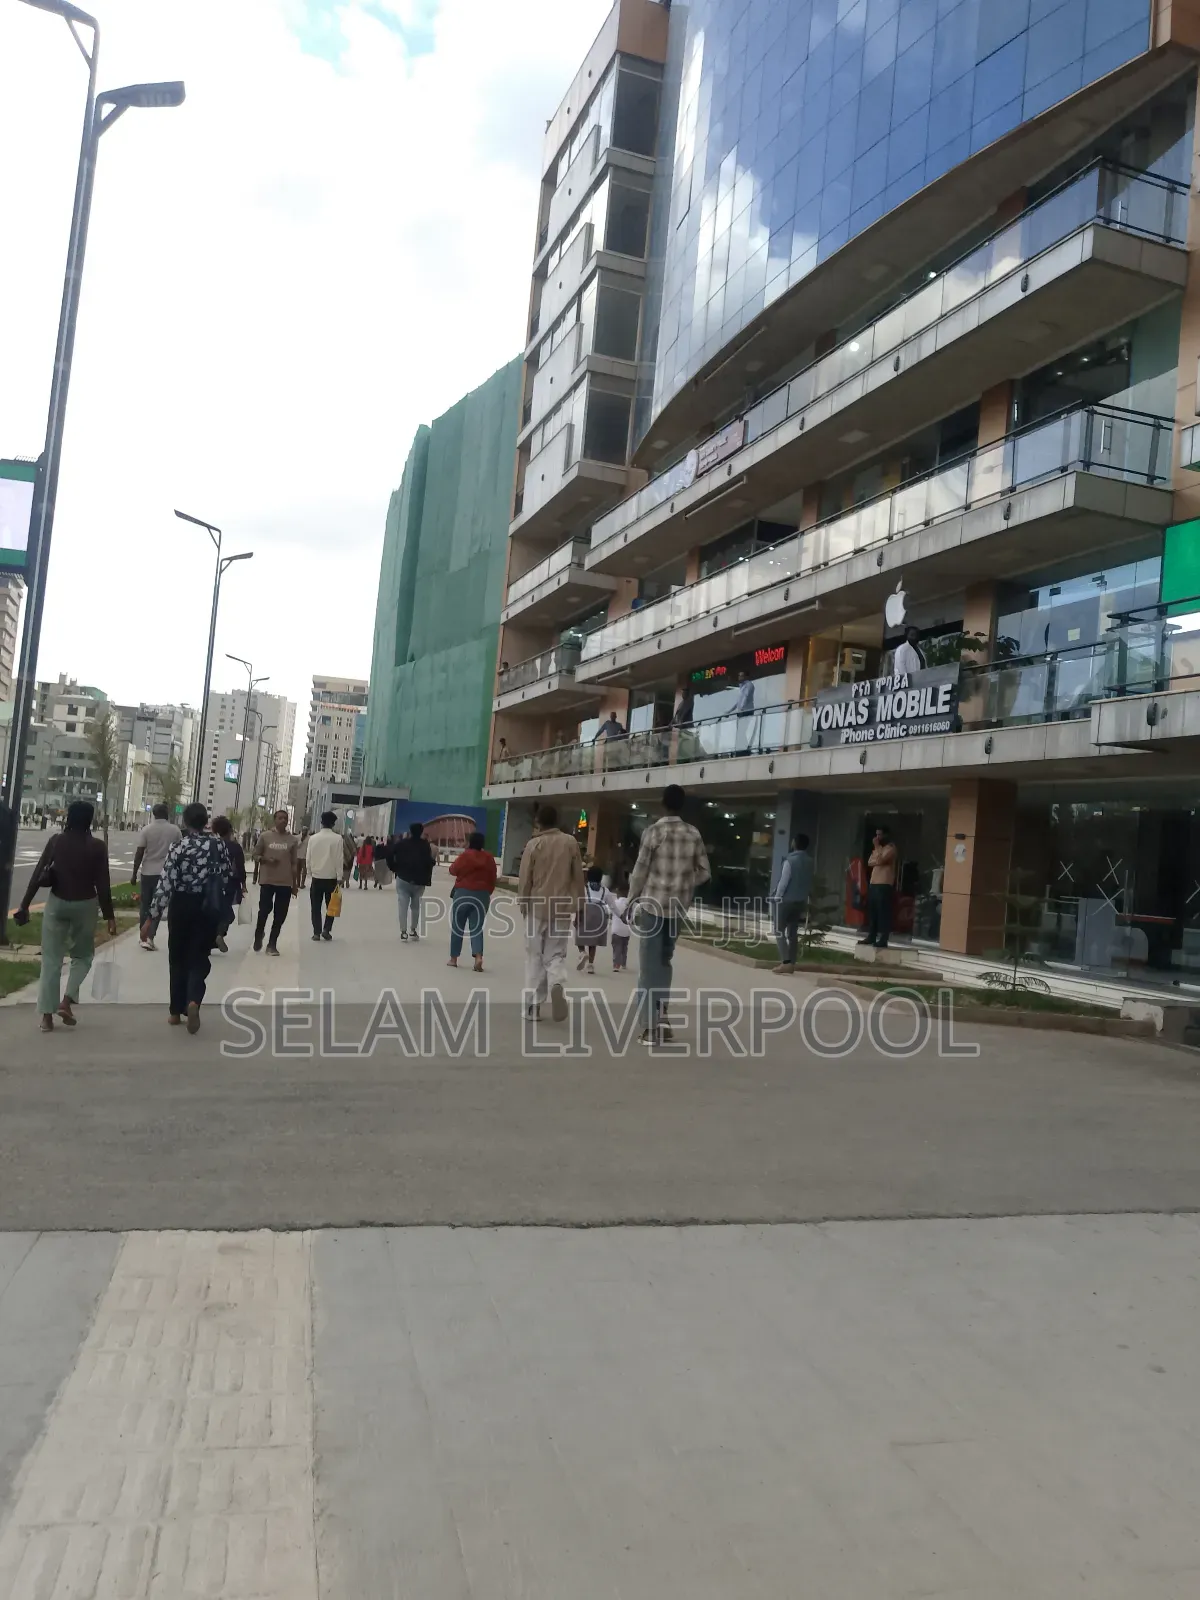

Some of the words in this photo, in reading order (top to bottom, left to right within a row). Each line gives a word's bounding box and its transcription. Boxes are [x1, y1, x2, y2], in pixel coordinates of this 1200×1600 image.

[812, 698, 870, 731] YONAS
[875, 683, 952, 722] MOBILE
[840, 727, 875, 744] iPhone
[876, 722, 907, 740] Clinic
